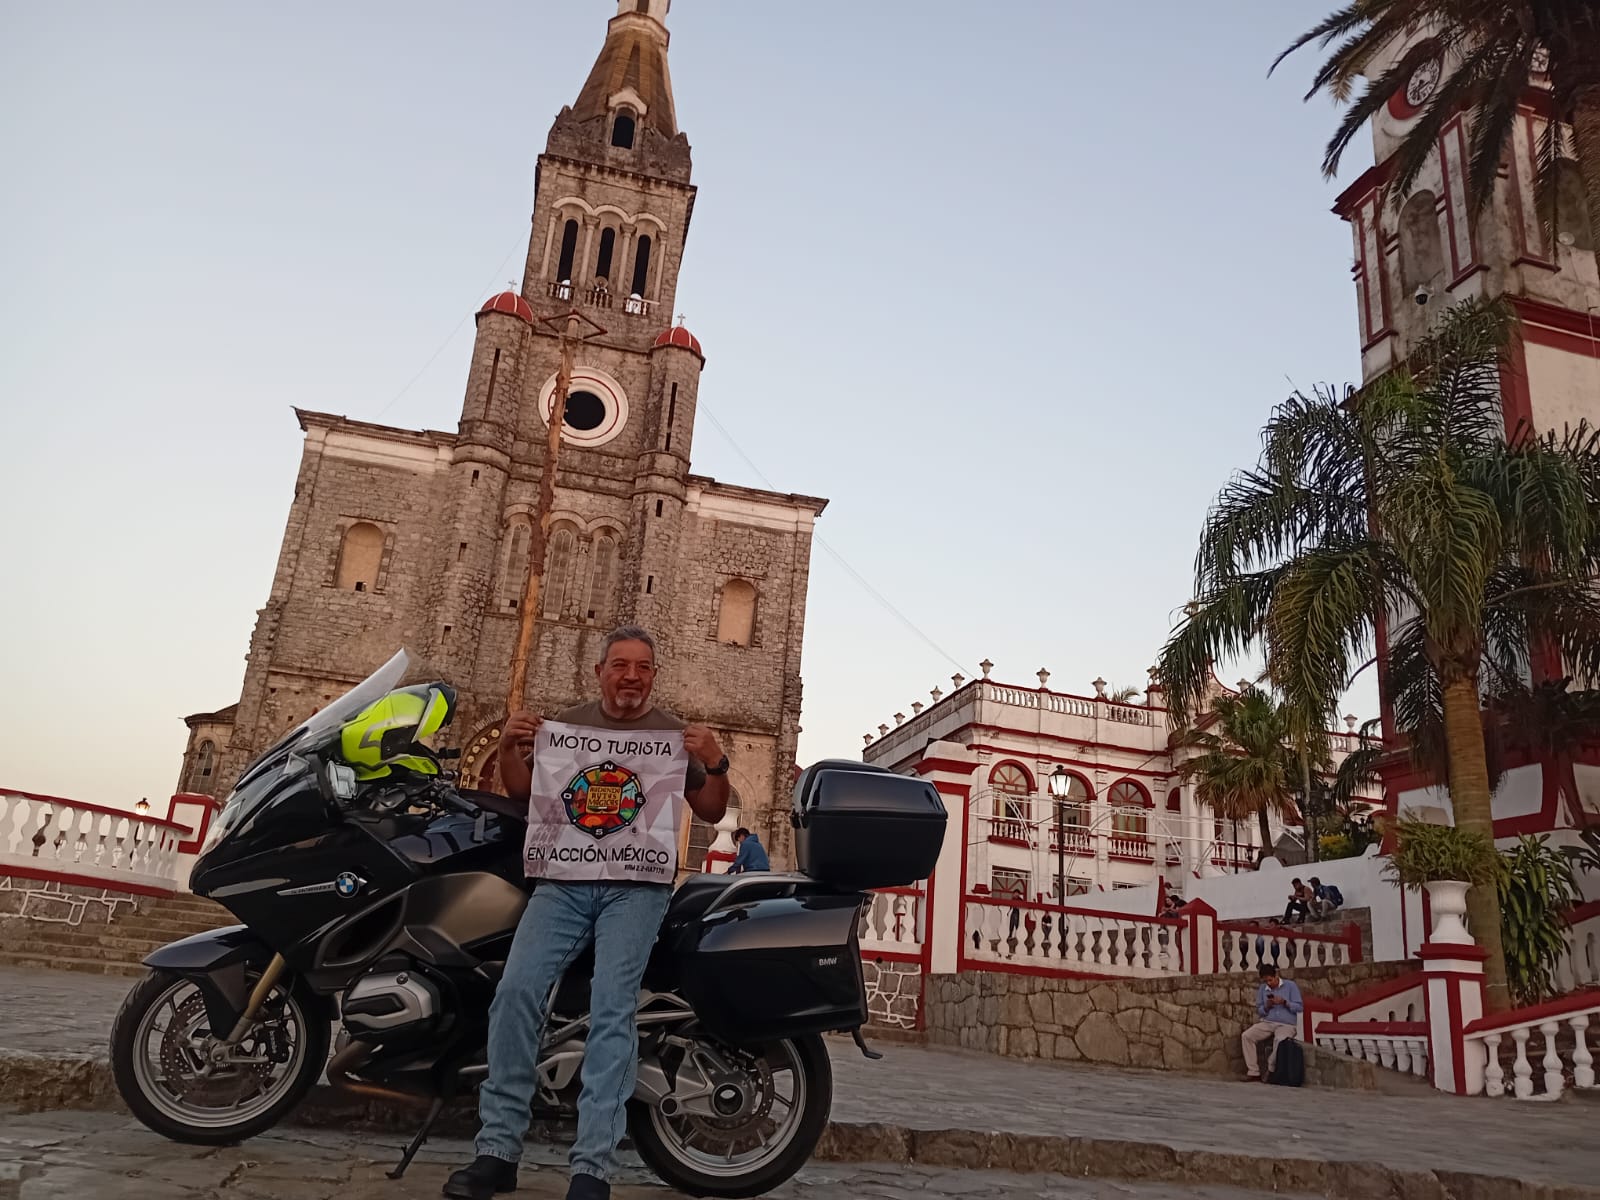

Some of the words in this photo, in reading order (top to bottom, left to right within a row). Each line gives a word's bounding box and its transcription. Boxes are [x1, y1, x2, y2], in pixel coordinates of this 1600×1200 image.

[549, 732, 602, 753] MOTO
[607, 740, 672, 756] TURISTA
[637, 796, 644, 804] E
[595, 828, 604, 836] S
[527, 847, 546, 861] EN
[548, 844, 608, 862] ACCIÓN
[611, 844, 669, 865] MÉXICO
[818, 956, 838, 966] BMW
